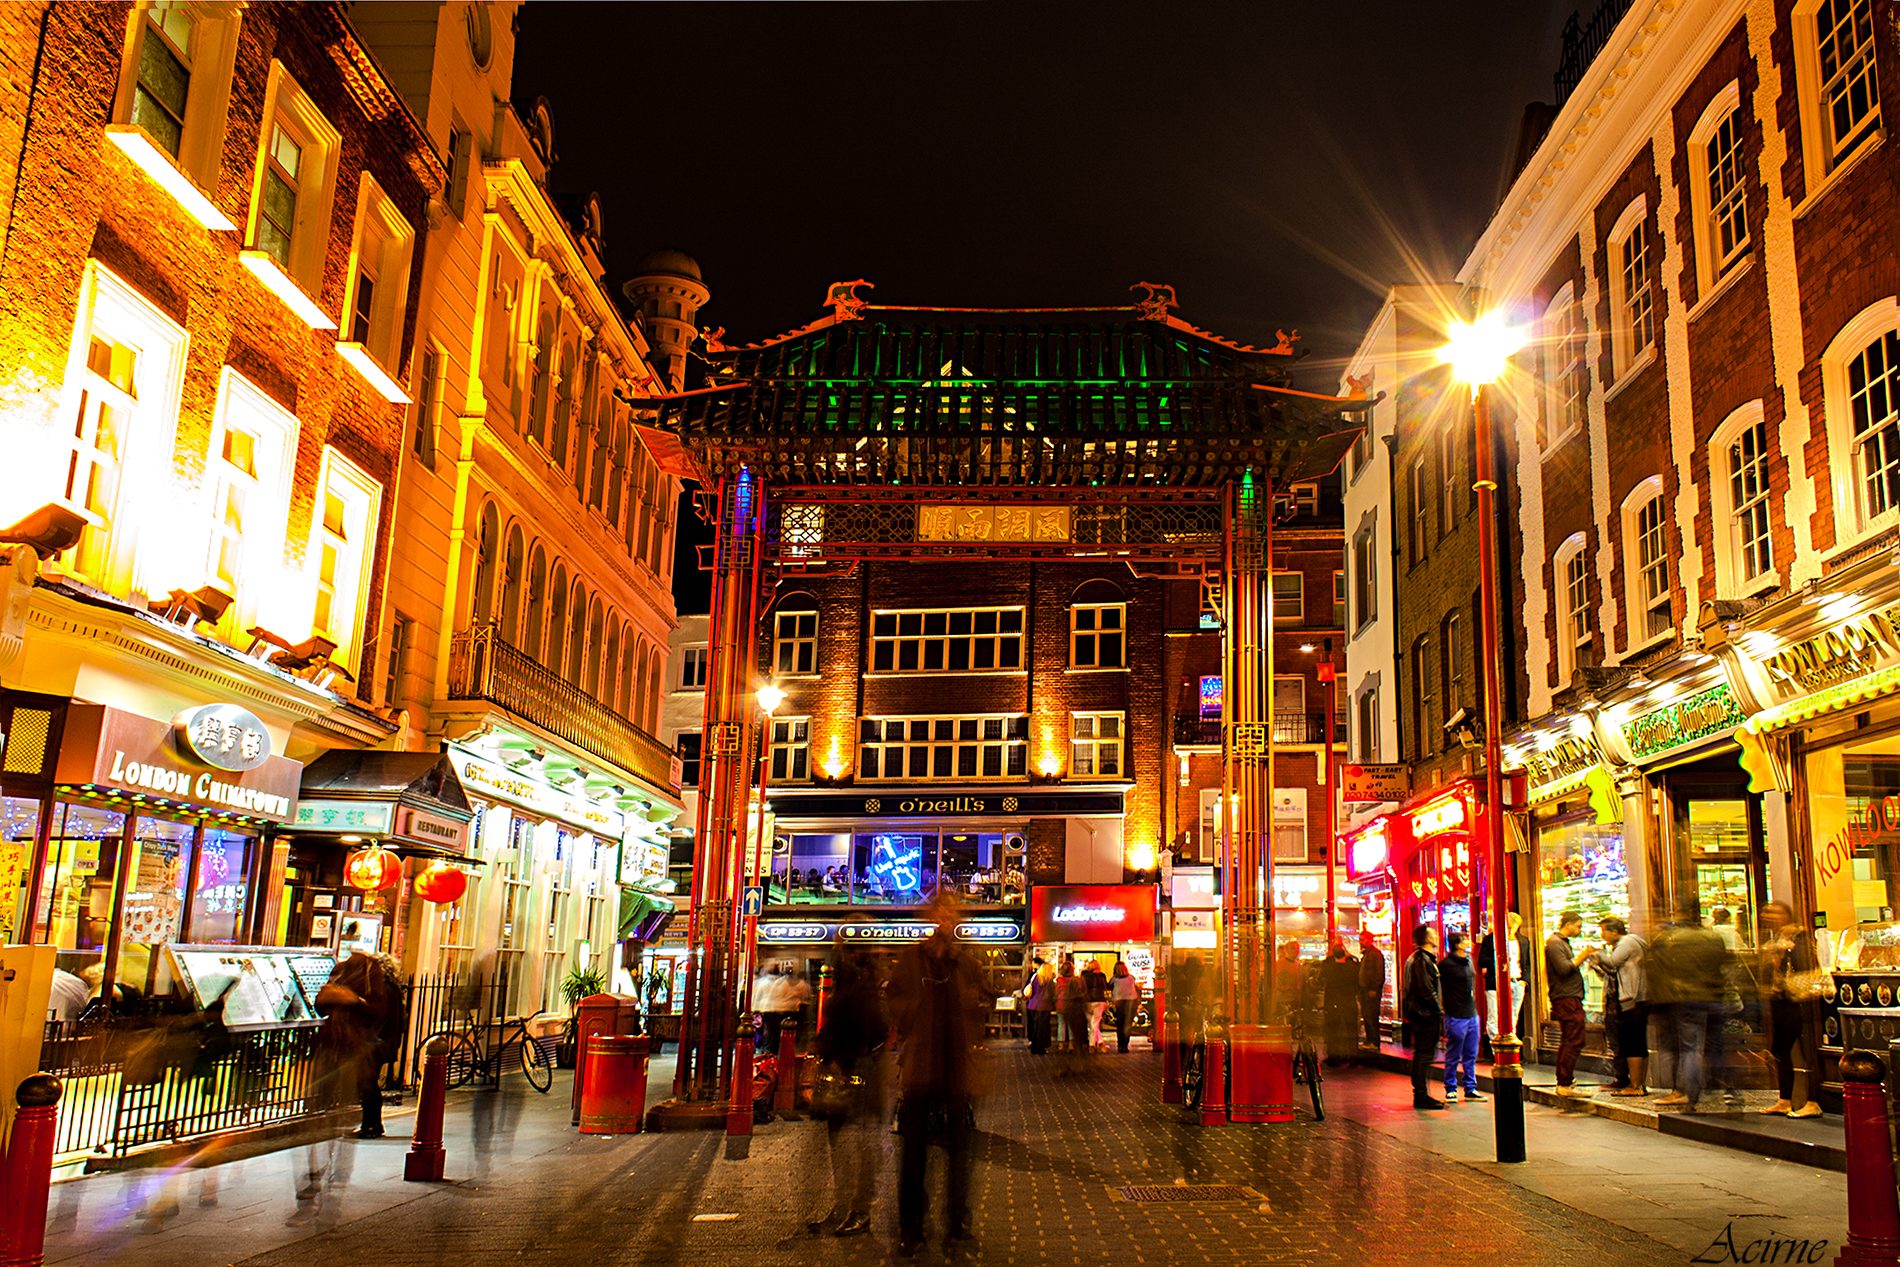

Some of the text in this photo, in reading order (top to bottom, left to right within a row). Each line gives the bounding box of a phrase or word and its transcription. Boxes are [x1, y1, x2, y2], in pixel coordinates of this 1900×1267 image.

[1760, 613, 1888, 684] KOWLOON
[109, 750, 290, 818] LONDON CHINATOWN
[417, 820, 458, 840] RESTAURANT
[77, 861, 95, 869] OPEN
[1052, 905, 1125, 921] Ladbrokes
